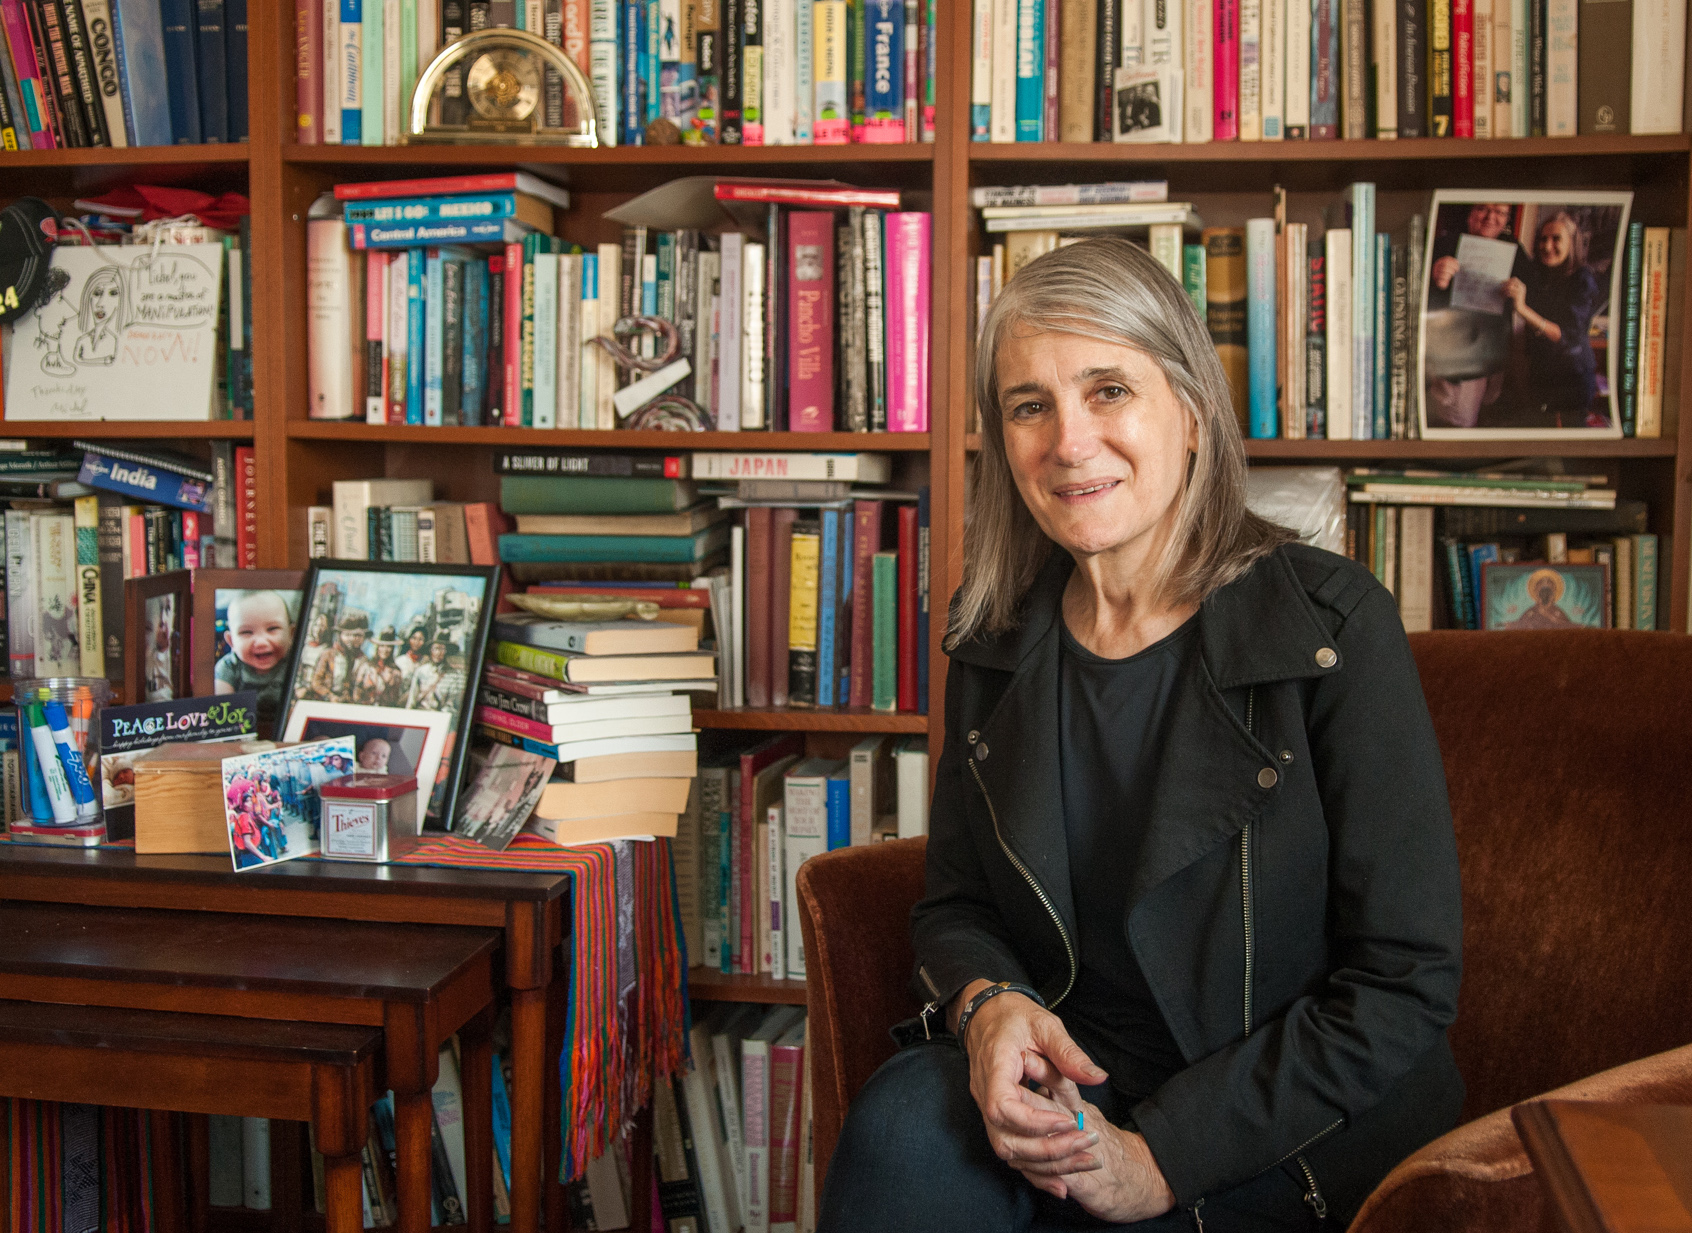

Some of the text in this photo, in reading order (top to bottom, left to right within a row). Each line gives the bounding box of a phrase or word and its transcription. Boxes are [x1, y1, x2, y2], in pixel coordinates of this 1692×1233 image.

[1407, 20, 1416, 34] An
[64, 3, 94, 104] NAME OF APARTHEID
[91, 18, 118, 98] CONGO
[875, 22, 894, 94] France
[1406, 36, 1417, 73] American
[1435, 115, 1449, 137] 7
[439, 201, 494, 218] MEXICO
[370, 224, 467, 242] Central America
[1311, 256, 1324, 332] STATIC
[523, 264, 534, 390] GARCIA MARQUEZ
[798, 290, 821, 380] Pancho Villa
[110, 463, 157, 490] India
[502, 456, 589, 472] A SLIVER OF LIGHT
[730, 457, 788, 476] JAPAN
[244, 457, 256, 534] JOURNEY
[6, 528, 22, 596] GELLHORN
[81, 568, 100, 604] CHINA
[112, 717, 165, 737] PEACE
[166, 712, 210, 730] LOVE
[208, 705, 220, 719] &
[511, 697, 530, 714] Crow
[332, 814, 369, 832] Thieves
